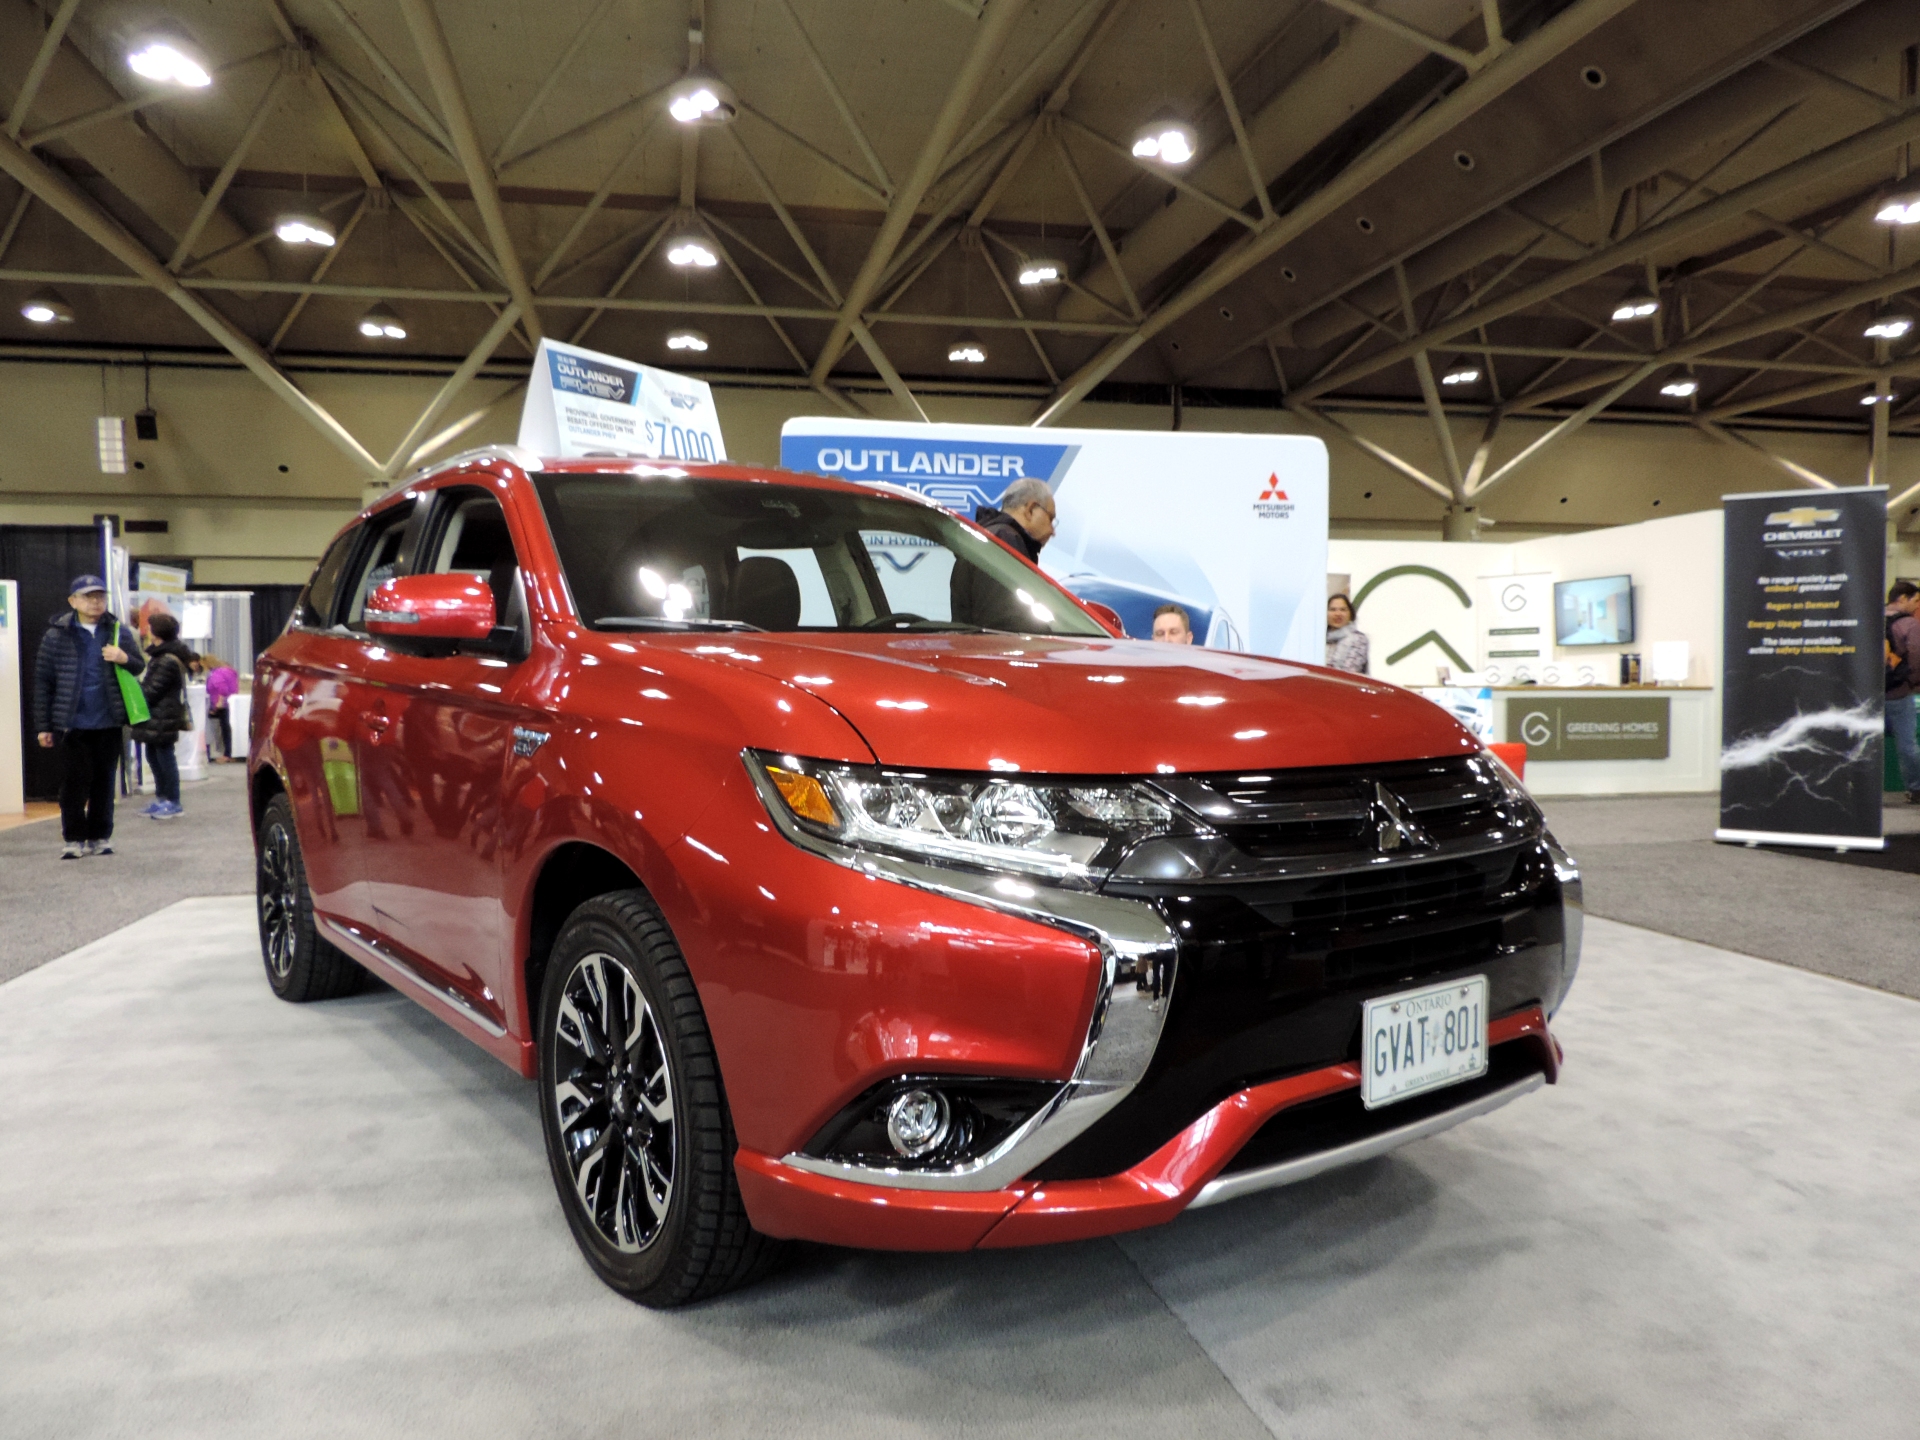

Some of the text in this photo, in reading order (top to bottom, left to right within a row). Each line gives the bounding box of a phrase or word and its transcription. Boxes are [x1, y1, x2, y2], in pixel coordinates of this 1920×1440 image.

[557, 363, 624, 387] OUTLANDER
[817, 448, 1025, 477] OUTLANDER
[1763, 528, 1843, 542] CHEVROLET
[1566, 722, 1659, 733] GREENING HOMES
[1406, 994, 1451, 1018] ONTARIO
[1374, 1003, 1480, 1077] GVAT 801
